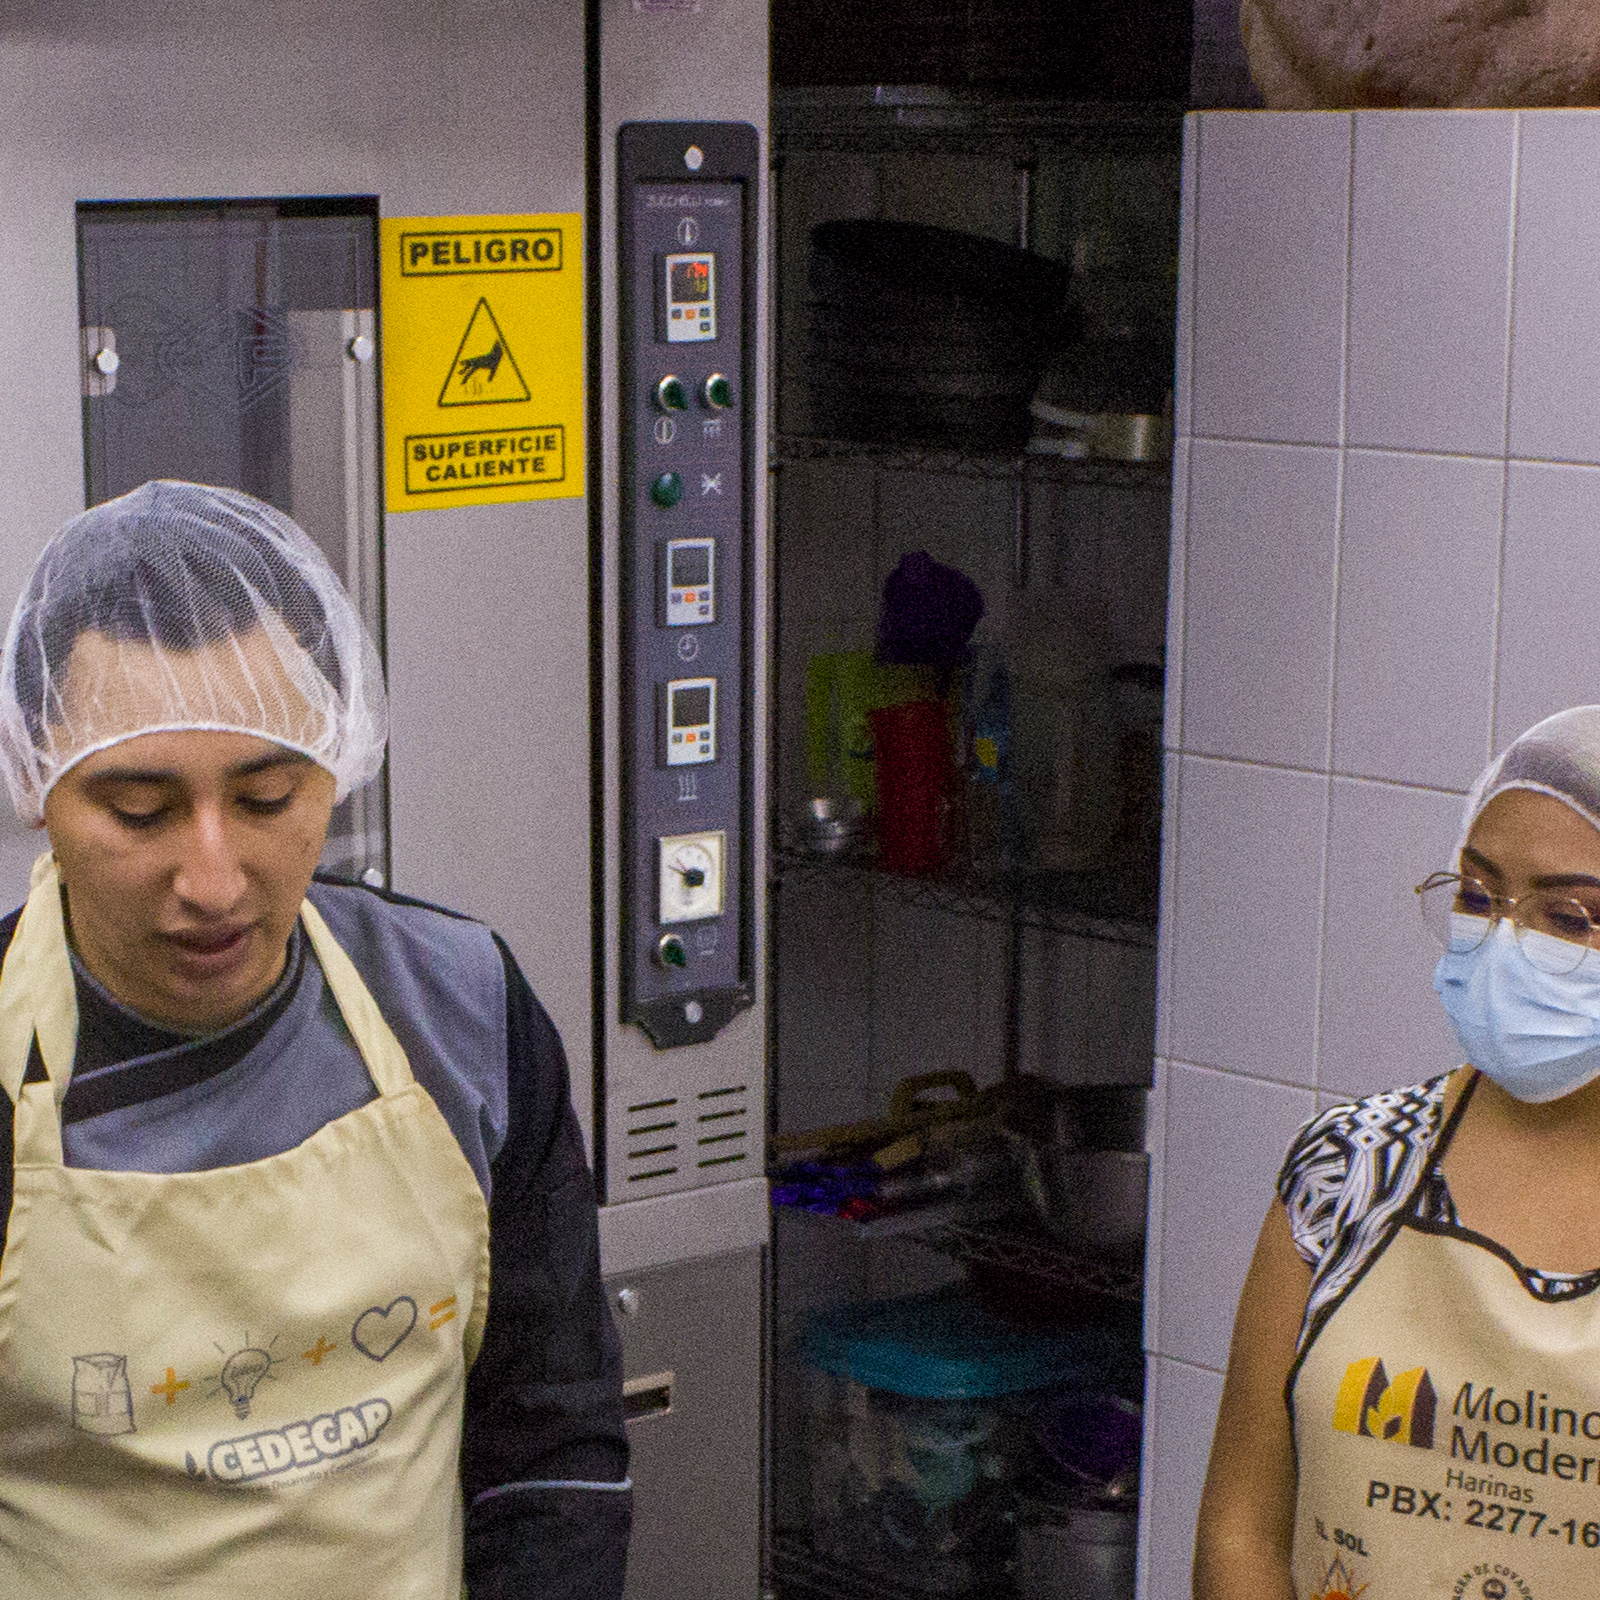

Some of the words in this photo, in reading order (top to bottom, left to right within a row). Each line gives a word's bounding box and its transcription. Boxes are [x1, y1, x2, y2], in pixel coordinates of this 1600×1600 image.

[409, 238, 555, 266] PELIGRO
[413, 434, 557, 461] SUPERFICIE
[425, 456, 546, 482] CALIENTE
[208, 1398, 392, 1483] CEDECAP
[1366, 1479, 1452, 1522] PBX:
[1445, 1467, 1535, 1503] Harinas
